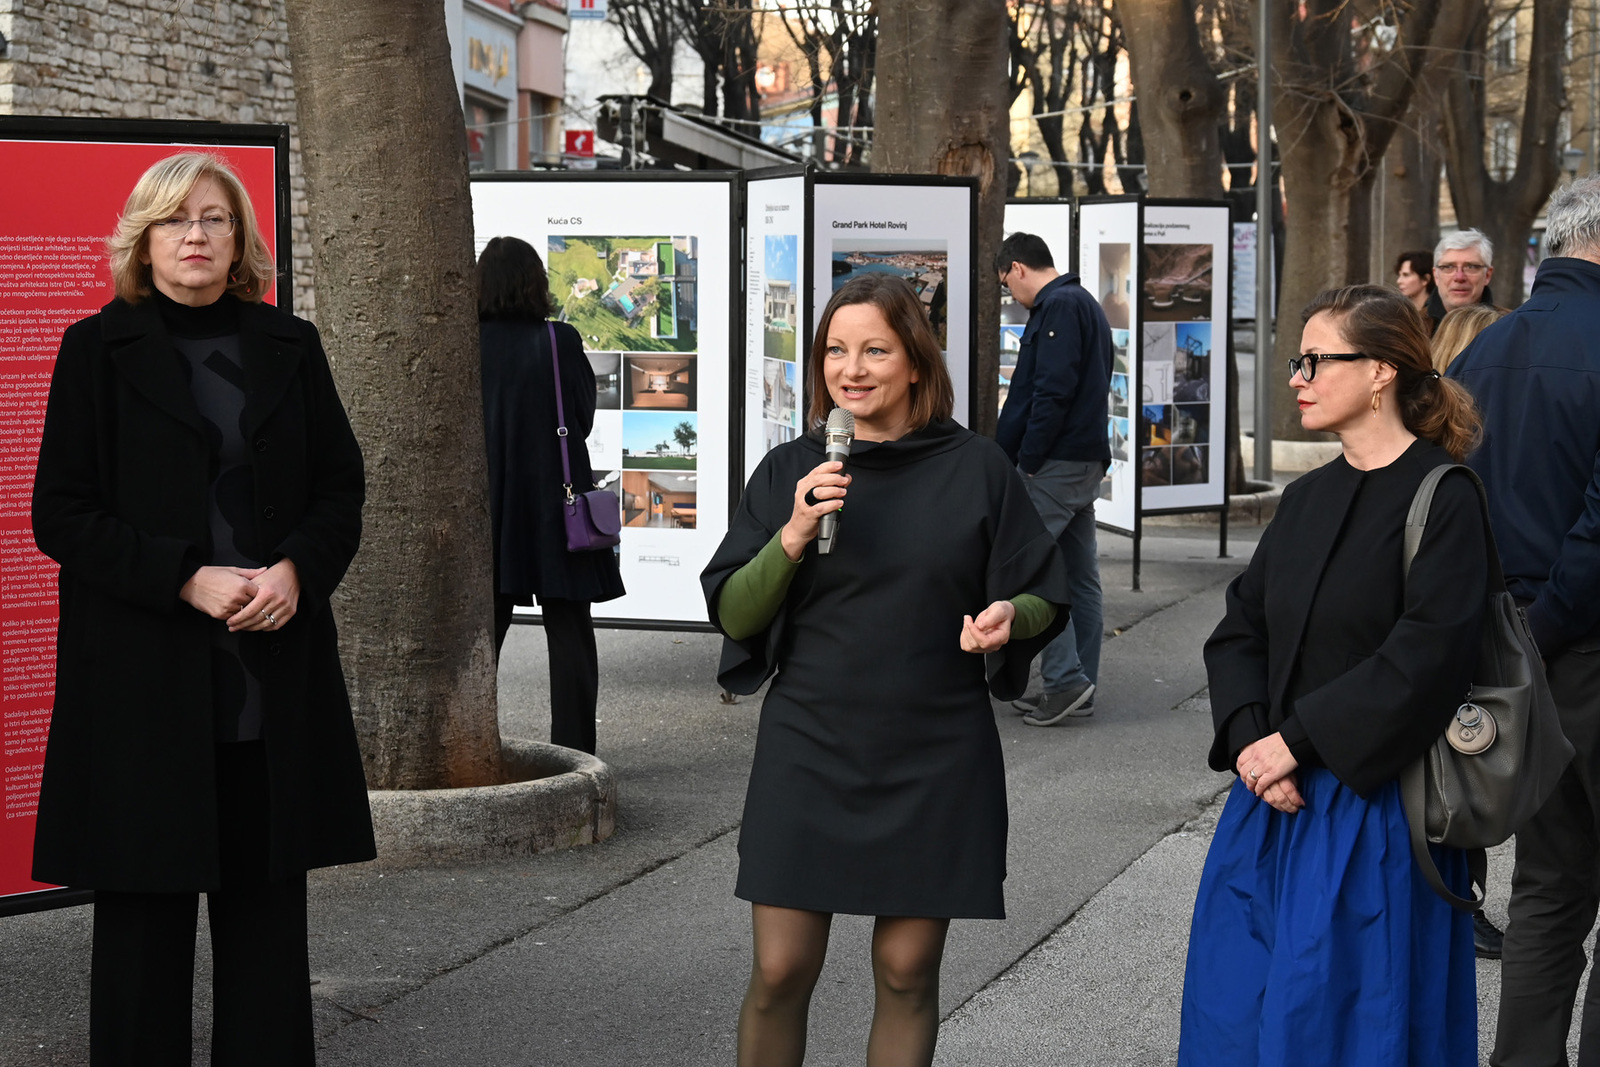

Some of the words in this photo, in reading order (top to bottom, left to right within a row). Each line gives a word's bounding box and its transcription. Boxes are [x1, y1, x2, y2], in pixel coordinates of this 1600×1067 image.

[548, 217, 568, 225] Kuća
[570, 217, 582, 225] CS
[832, 221, 852, 229] Grand
[854, 221, 868, 229] Park
[869, 221, 886, 229] Hotel
[888, 221, 907, 231] Rovinj
[23, 418, 45, 426] aplikacij
[38, 563, 61, 571] površina
[6, 792, 40, 802] poljoprivred
[6, 801, 38, 809] infrastruktu
